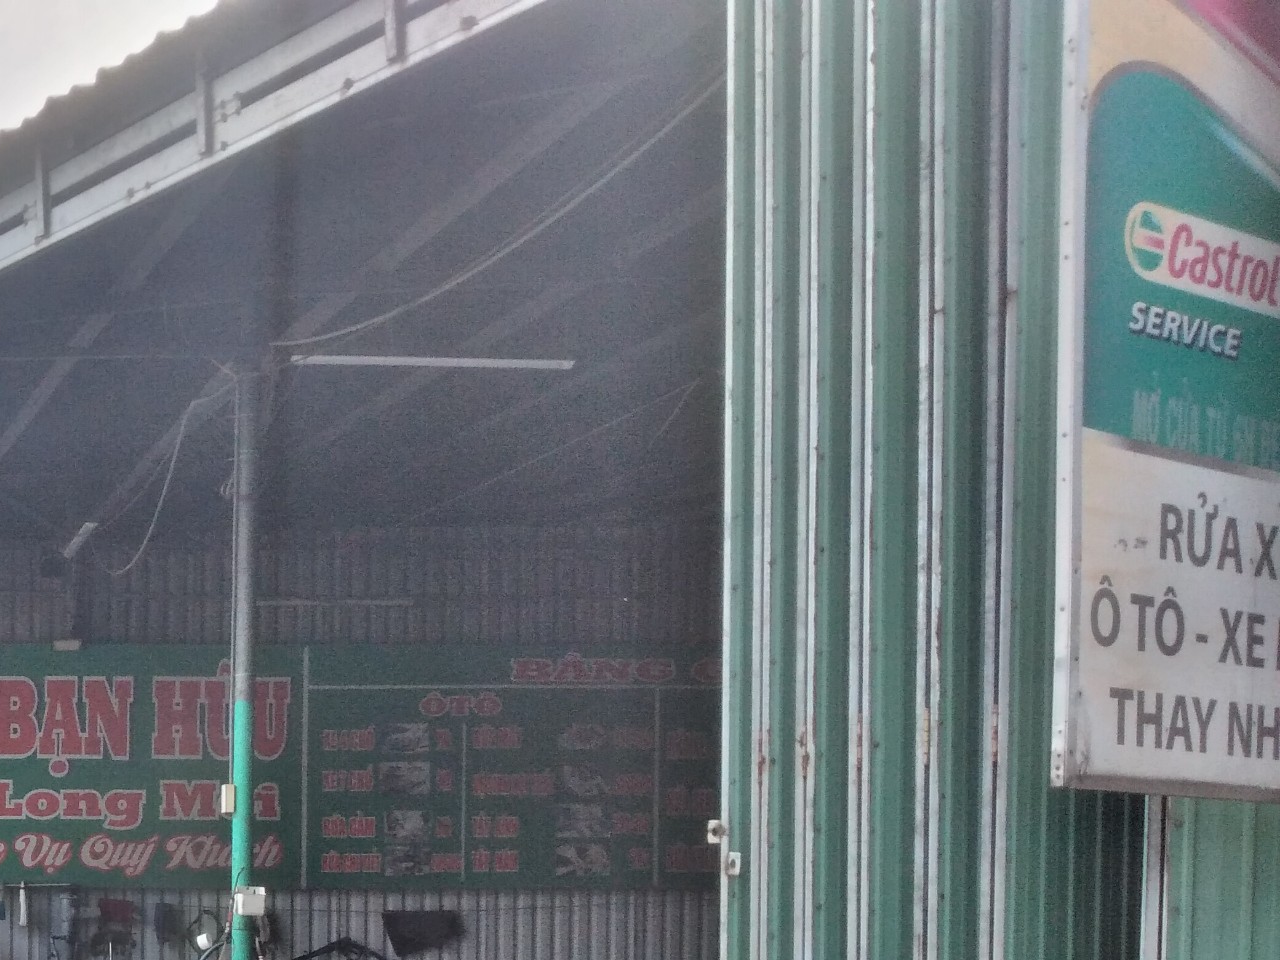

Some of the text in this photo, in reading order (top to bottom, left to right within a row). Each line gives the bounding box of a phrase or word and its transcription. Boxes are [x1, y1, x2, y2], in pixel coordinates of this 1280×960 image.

[1167, 223, 1280, 306] Castrol
[1129, 301, 1243, 358] SERVICE
[1159, 491, 1243, 574] RỬA
[1090, 574, 1120, 648] Ô
[1130, 586, 1185, 657] TÔ
[1218, 606, 1265, 670] XE
[1109, 686, 1217, 754] THAY
[160, 779, 280, 821] Mi
[15, 831, 72, 875] Vụ
[79, 831, 158, 878] Quý
